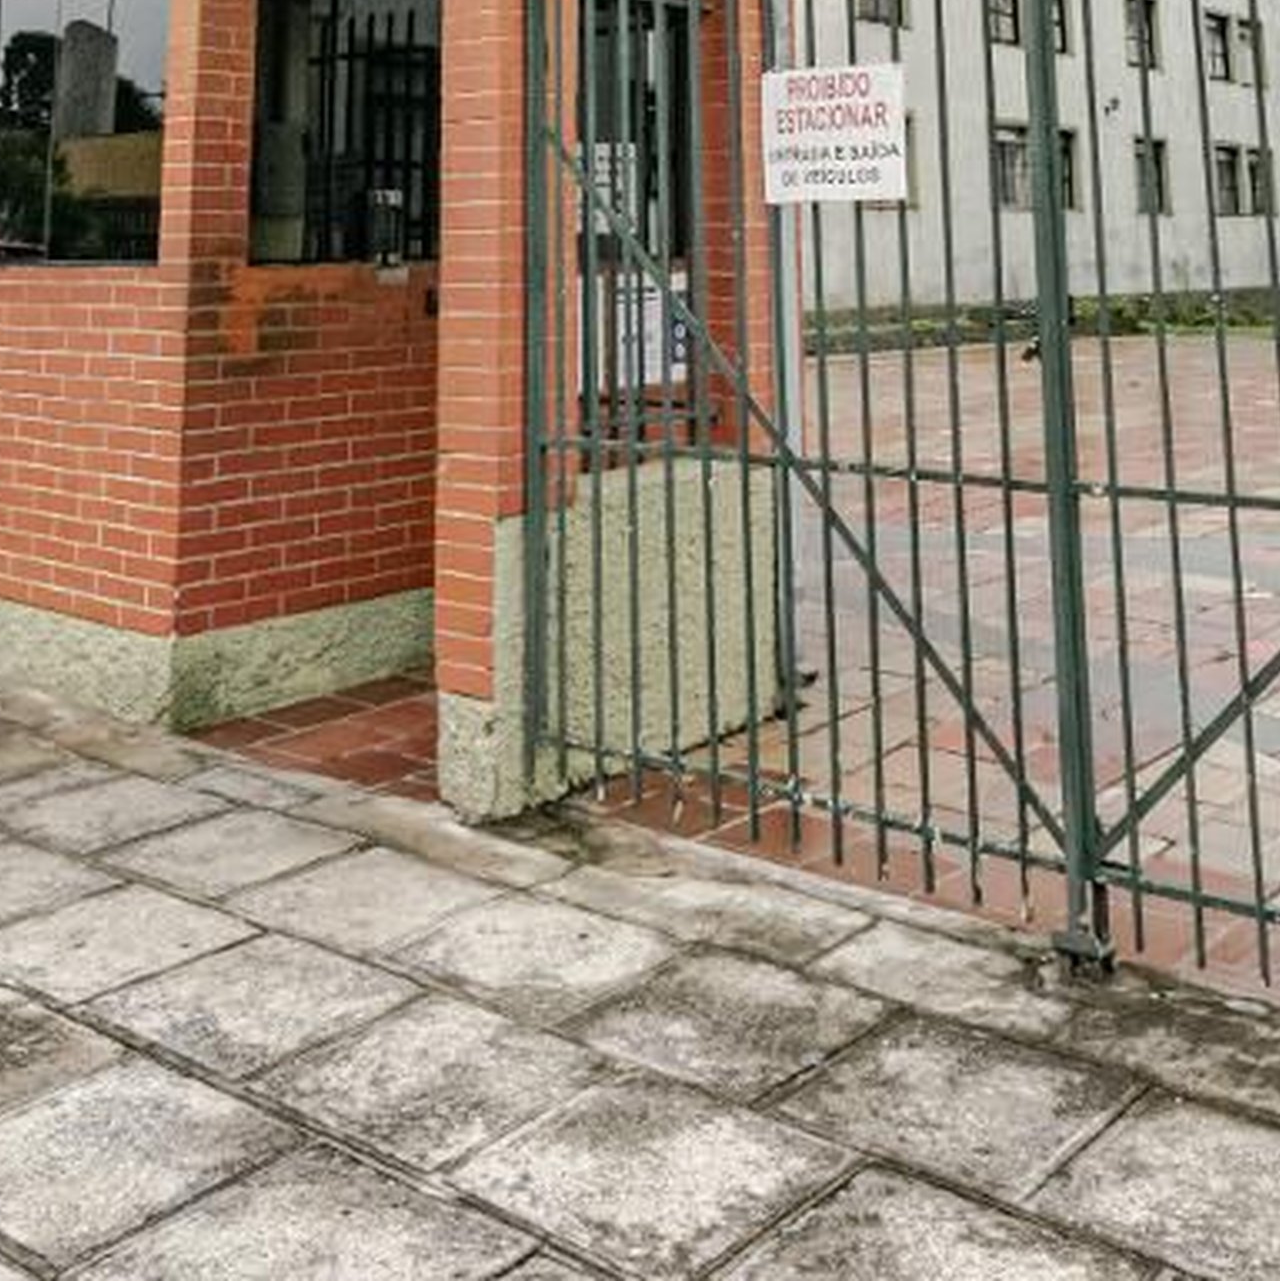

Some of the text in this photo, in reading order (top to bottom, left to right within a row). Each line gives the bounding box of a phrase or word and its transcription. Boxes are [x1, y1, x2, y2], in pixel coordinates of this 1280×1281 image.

[787, 73, 870, 101] PROIBIDO
[776, 103, 888, 134] ESTACIONAR
[835, 144, 846, 160] E
